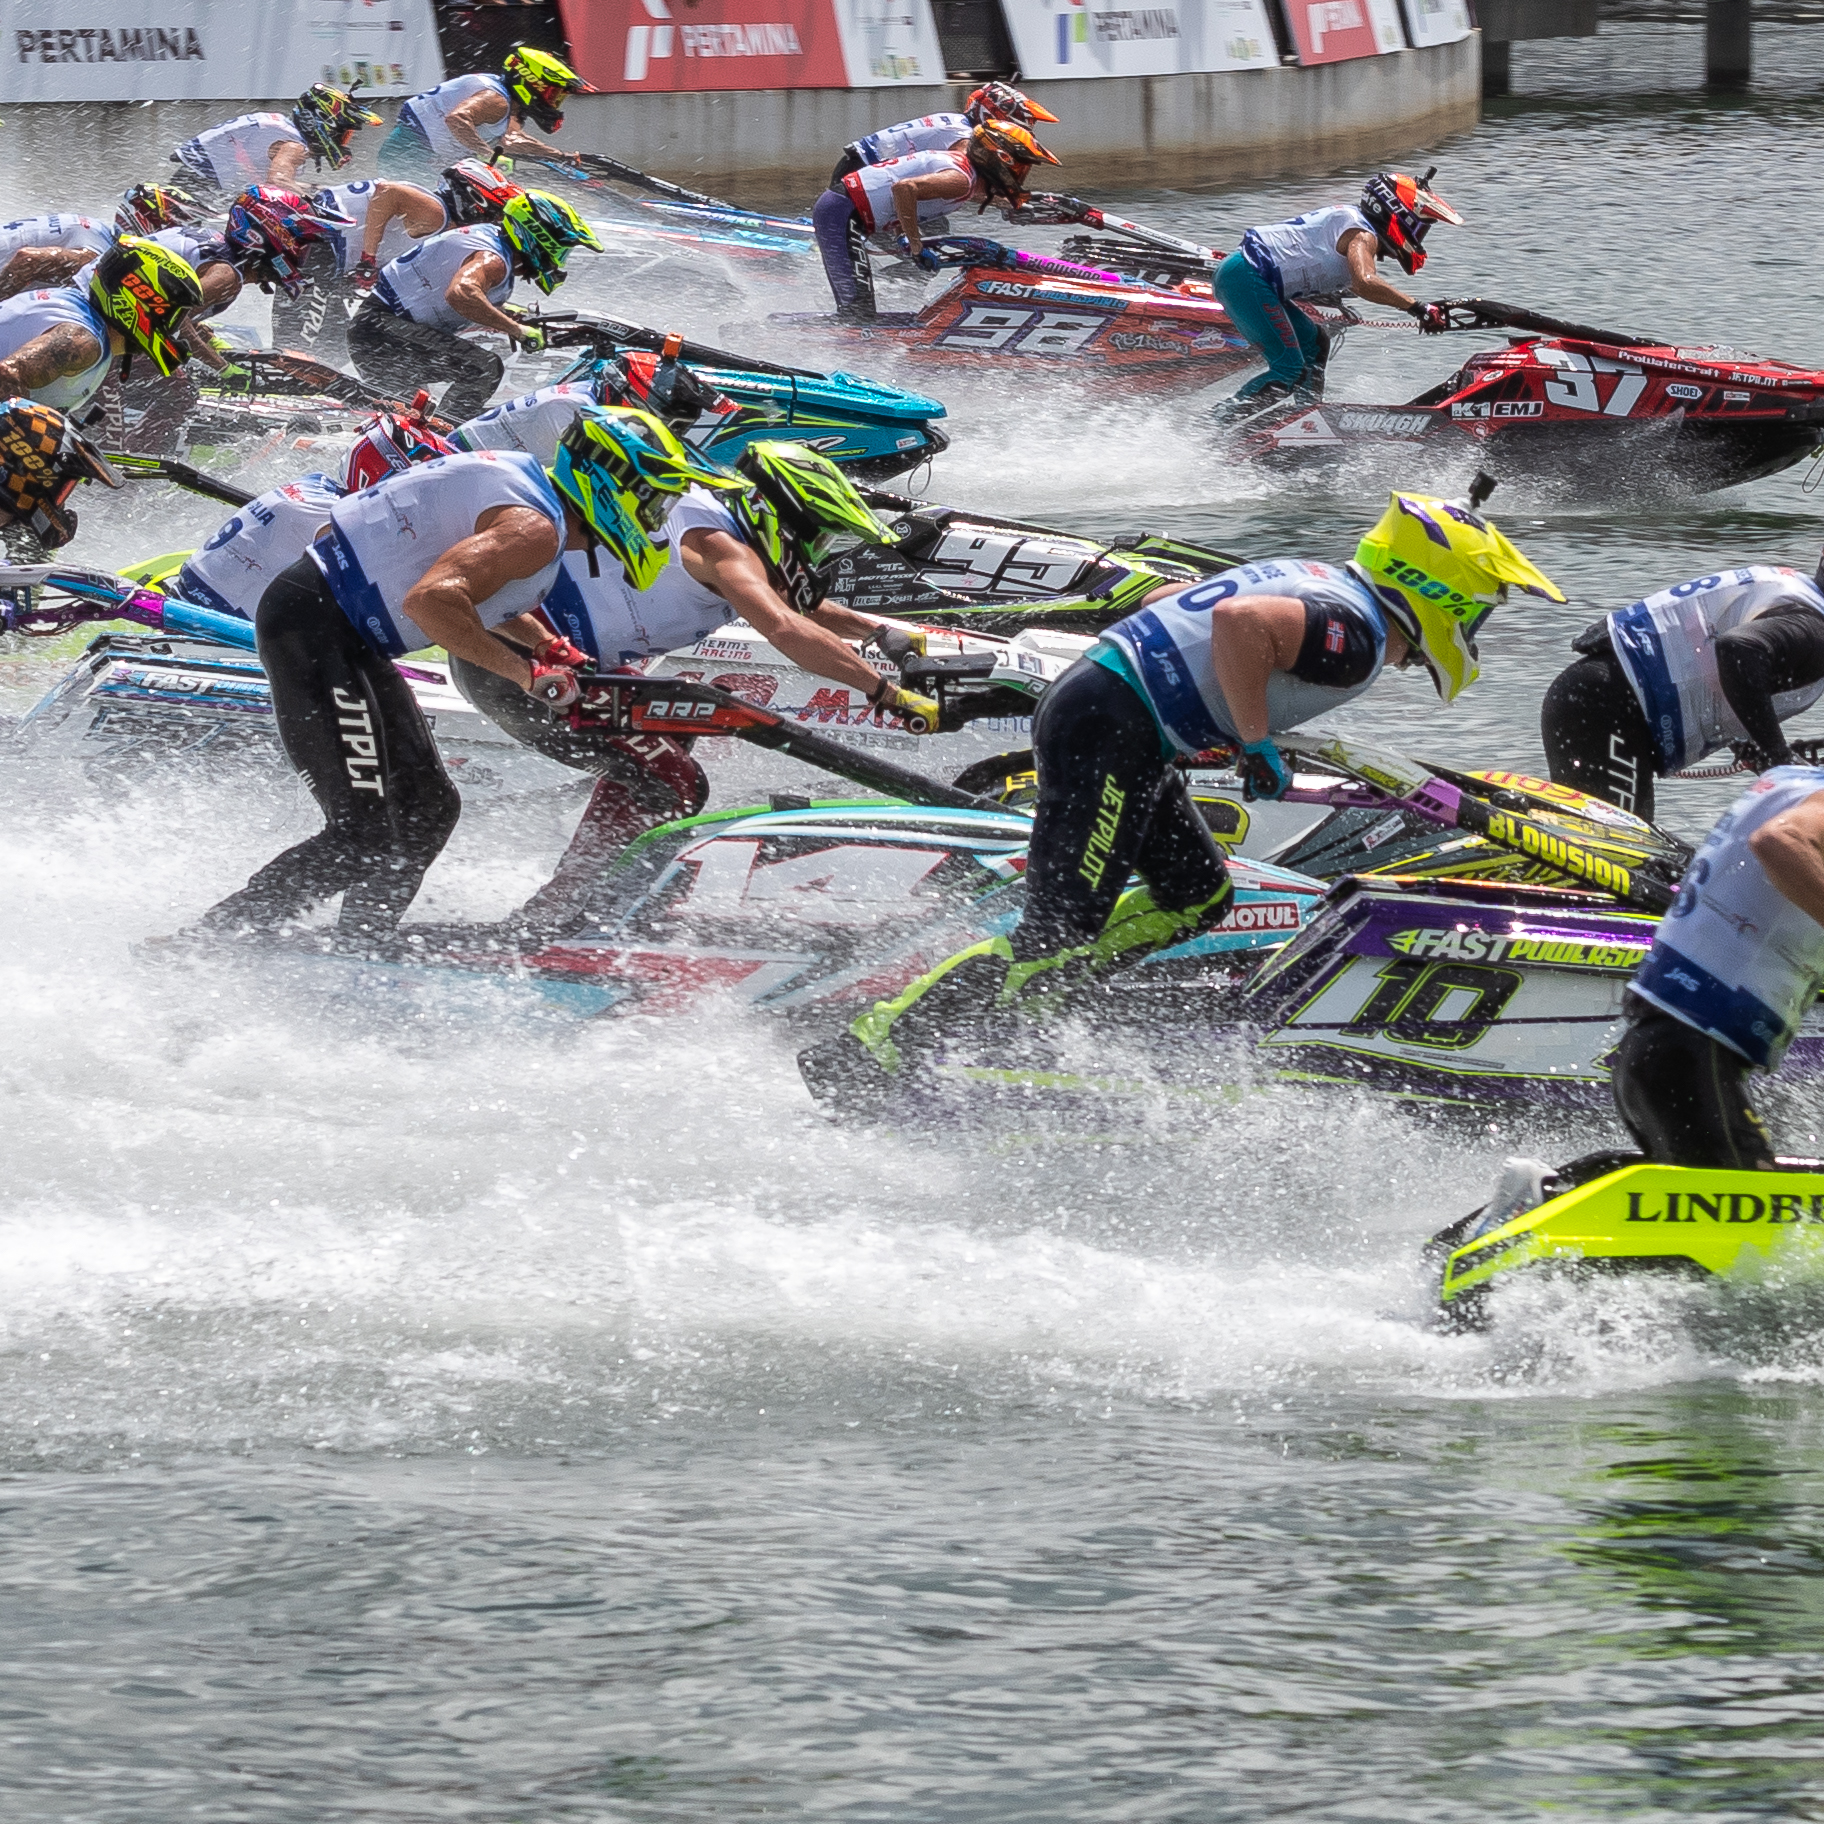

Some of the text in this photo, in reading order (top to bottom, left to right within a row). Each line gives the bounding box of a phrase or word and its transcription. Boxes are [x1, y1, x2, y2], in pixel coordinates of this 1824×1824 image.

[15, 28, 206, 64] PERTAMINA
[1373, 180, 1409, 215] TPLT
[987, 280, 1034, 298] FAST
[1534, 347, 1648, 417] 37
[1669, 386, 1699, 399] SHOEI
[1494, 402, 1542, 416] EMJ
[1382, 556, 1474, 619] 100%
[142, 672, 214, 694] FAST
[332, 686, 384, 797] JTPLT
[1086, 773, 1127, 890] JETPILOT
[1488, 814, 1631, 896] BLOWSION
[1414, 928, 1646, 970] FAST POWERSP
